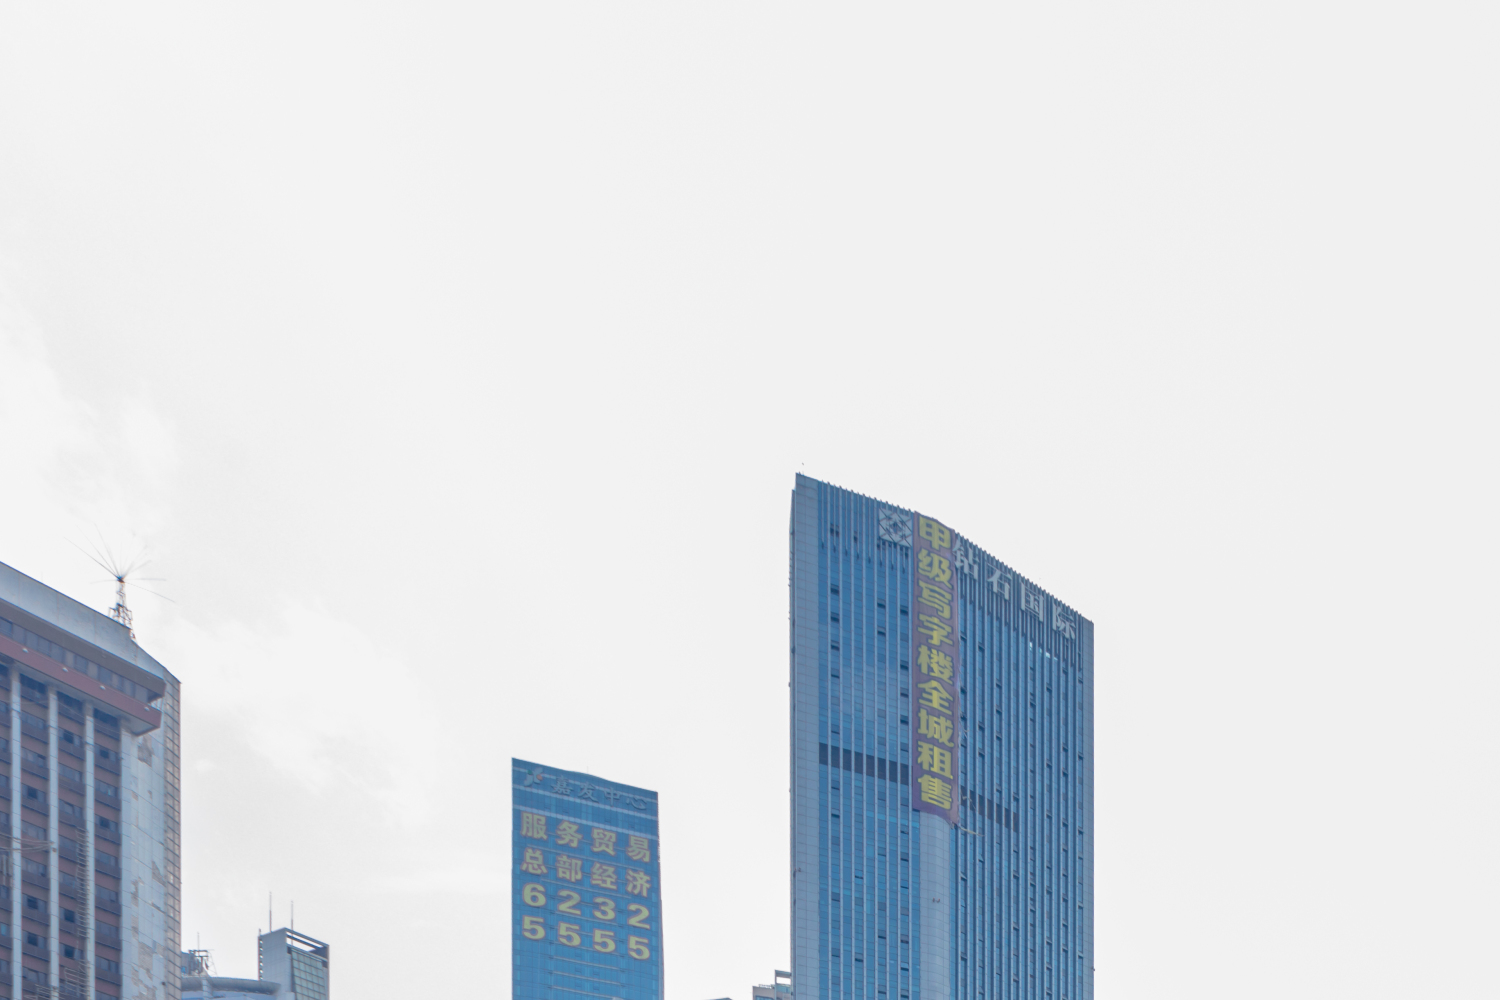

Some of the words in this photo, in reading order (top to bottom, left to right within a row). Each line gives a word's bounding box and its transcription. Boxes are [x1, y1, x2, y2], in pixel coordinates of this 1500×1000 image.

[952, 539, 1076, 640] 钻石国际
[917, 515, 954, 811] 甲级写字楼全城租售
[551, 774, 648, 810] 嘉发中心
[520, 811, 651, 863] 服务贸易
[520, 847, 652, 898] 总部经济
[522, 883, 650, 930] 6232
[522, 915, 650, 961] 5555
